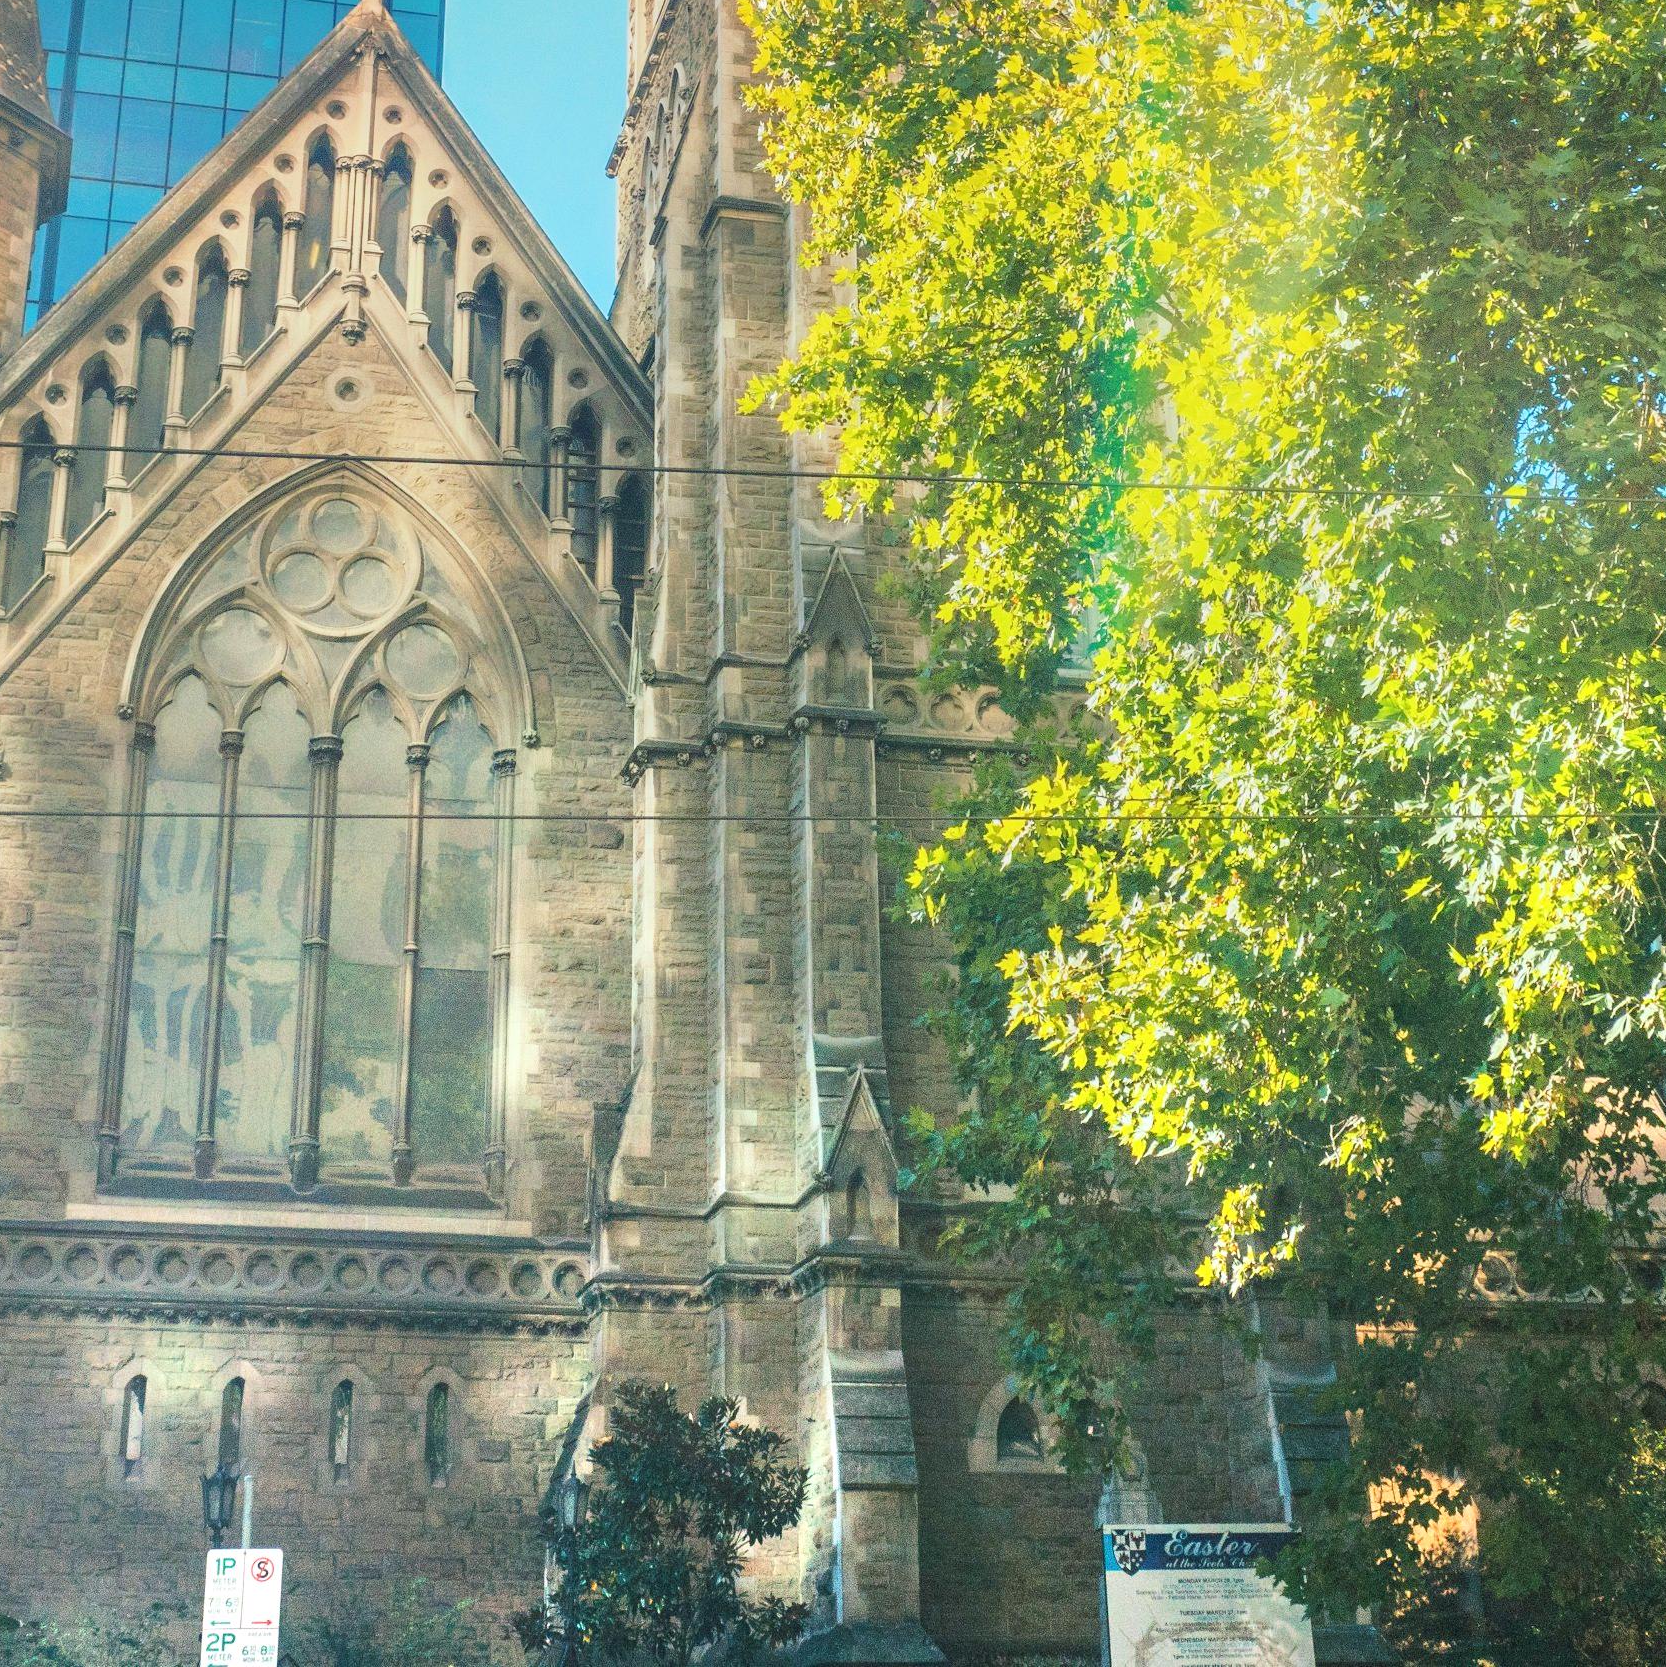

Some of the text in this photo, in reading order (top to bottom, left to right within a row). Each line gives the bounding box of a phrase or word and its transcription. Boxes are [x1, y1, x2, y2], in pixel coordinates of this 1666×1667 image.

[1164, 1529, 1259, 1556] Easter
[216, 1557, 236, 1575] 1P
[1166, 1559, 1178, 1568] at
[1180, 1558, 1194, 1568] the
[206, 1633, 236, 1651] 2P
[208, 1653, 232, 1661] METER
